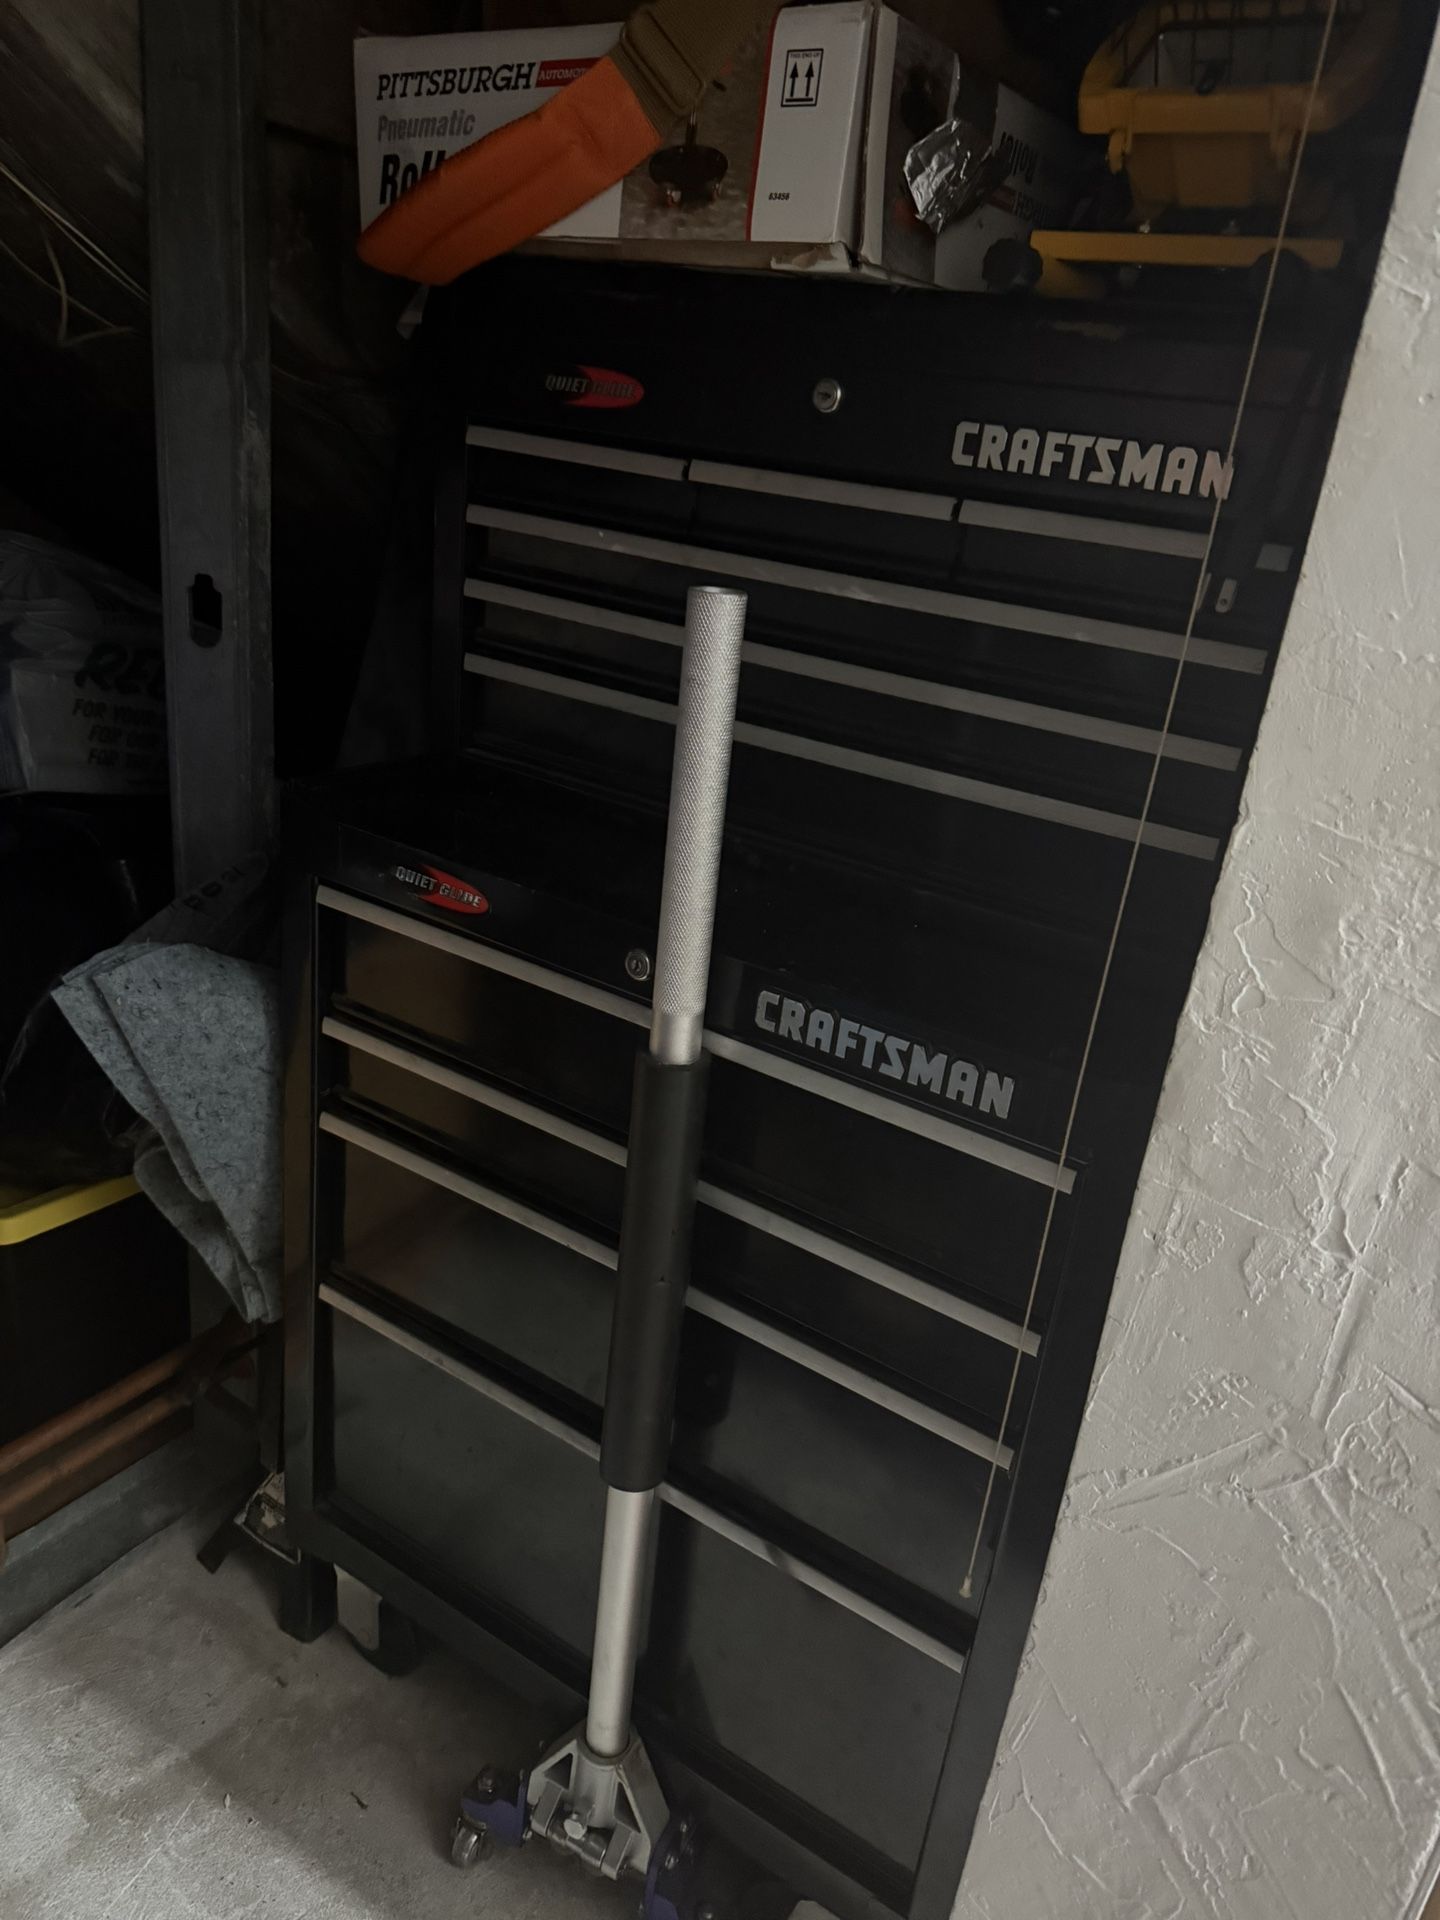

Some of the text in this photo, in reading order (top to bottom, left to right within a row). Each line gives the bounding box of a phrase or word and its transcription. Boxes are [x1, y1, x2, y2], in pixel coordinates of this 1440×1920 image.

[376, 62, 587, 101] PITTSBURGH AUTOMOT
[377, 109, 476, 142] Pneumatic
[544, 374, 590, 393] QUIET
[951, 420, 1234, 500] CRAFTSMAN
[72, 698, 107, 721] FOR
[88, 748, 119, 767] FOR
[395, 865, 482, 908] QUIET GLIDE
[753, 990, 1016, 1120] CRAFTSMAN
